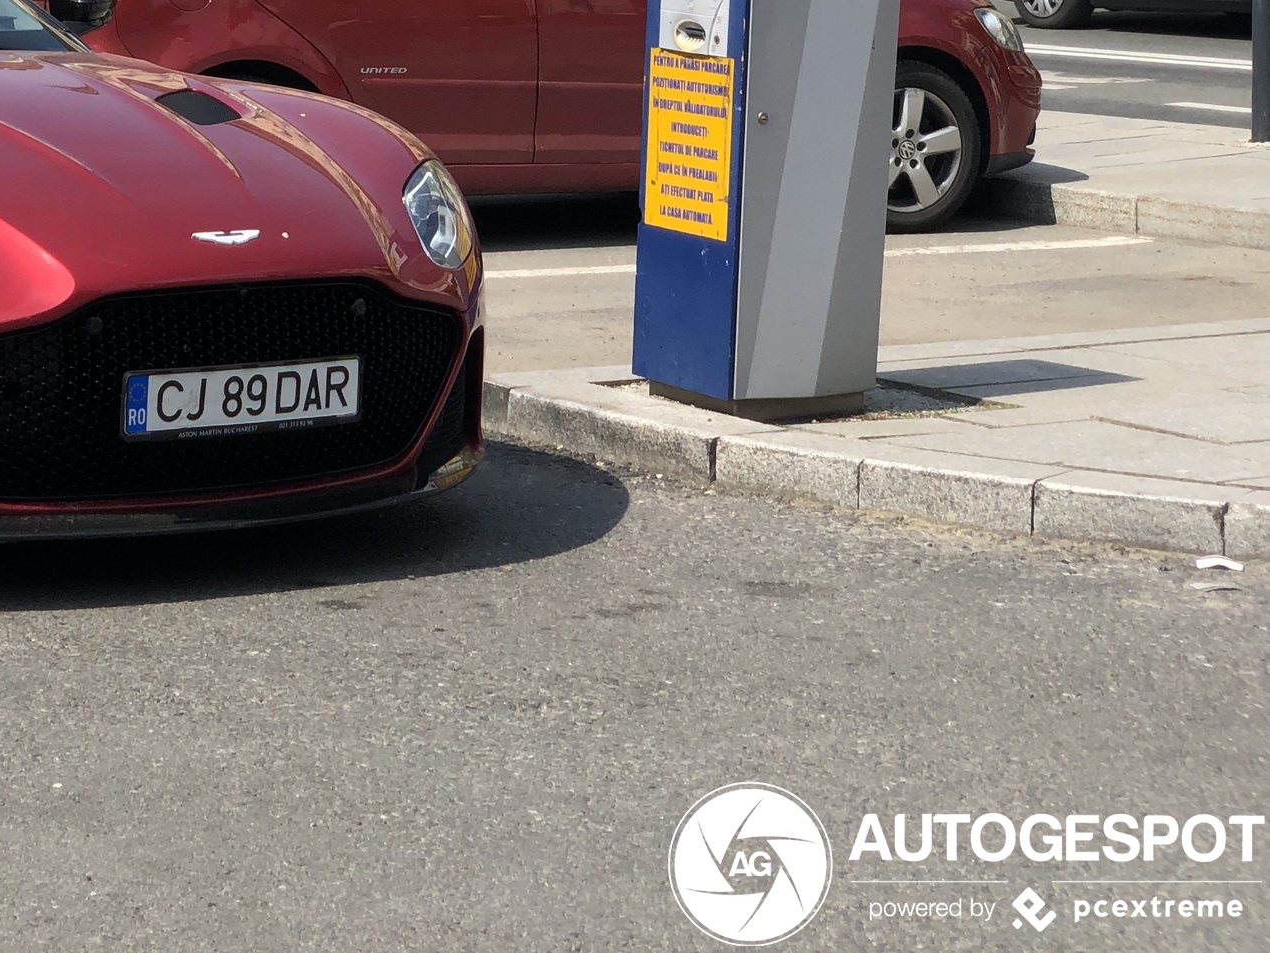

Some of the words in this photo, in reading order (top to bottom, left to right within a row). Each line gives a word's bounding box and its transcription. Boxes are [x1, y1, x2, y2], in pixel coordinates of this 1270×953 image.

[653, 55, 675, 69] PENTRU
[659, 98, 683, 112] DREPTUL
[659, 140, 685, 155] TICHETUL
[685, 145, 693, 157] DE
[693, 146, 718, 161] PARCARE
[673, 165, 681, 176] CE
[670, 185, 696, 200] EFECTUAT
[697, 190, 714, 204] PLATA
[659, 204, 666, 216] LA
[667, 206, 682, 219] CASA
[157, 379, 207, 423] CJ
[222, 374, 268, 418] 89
[275, 365, 350, 415] DAR
[128, 408, 146, 426] RO
[178, 430, 198, 439] ASTON
[198, 428, 223, 437] MARTIN
[224, 425, 259, 434] BUCHAREST
